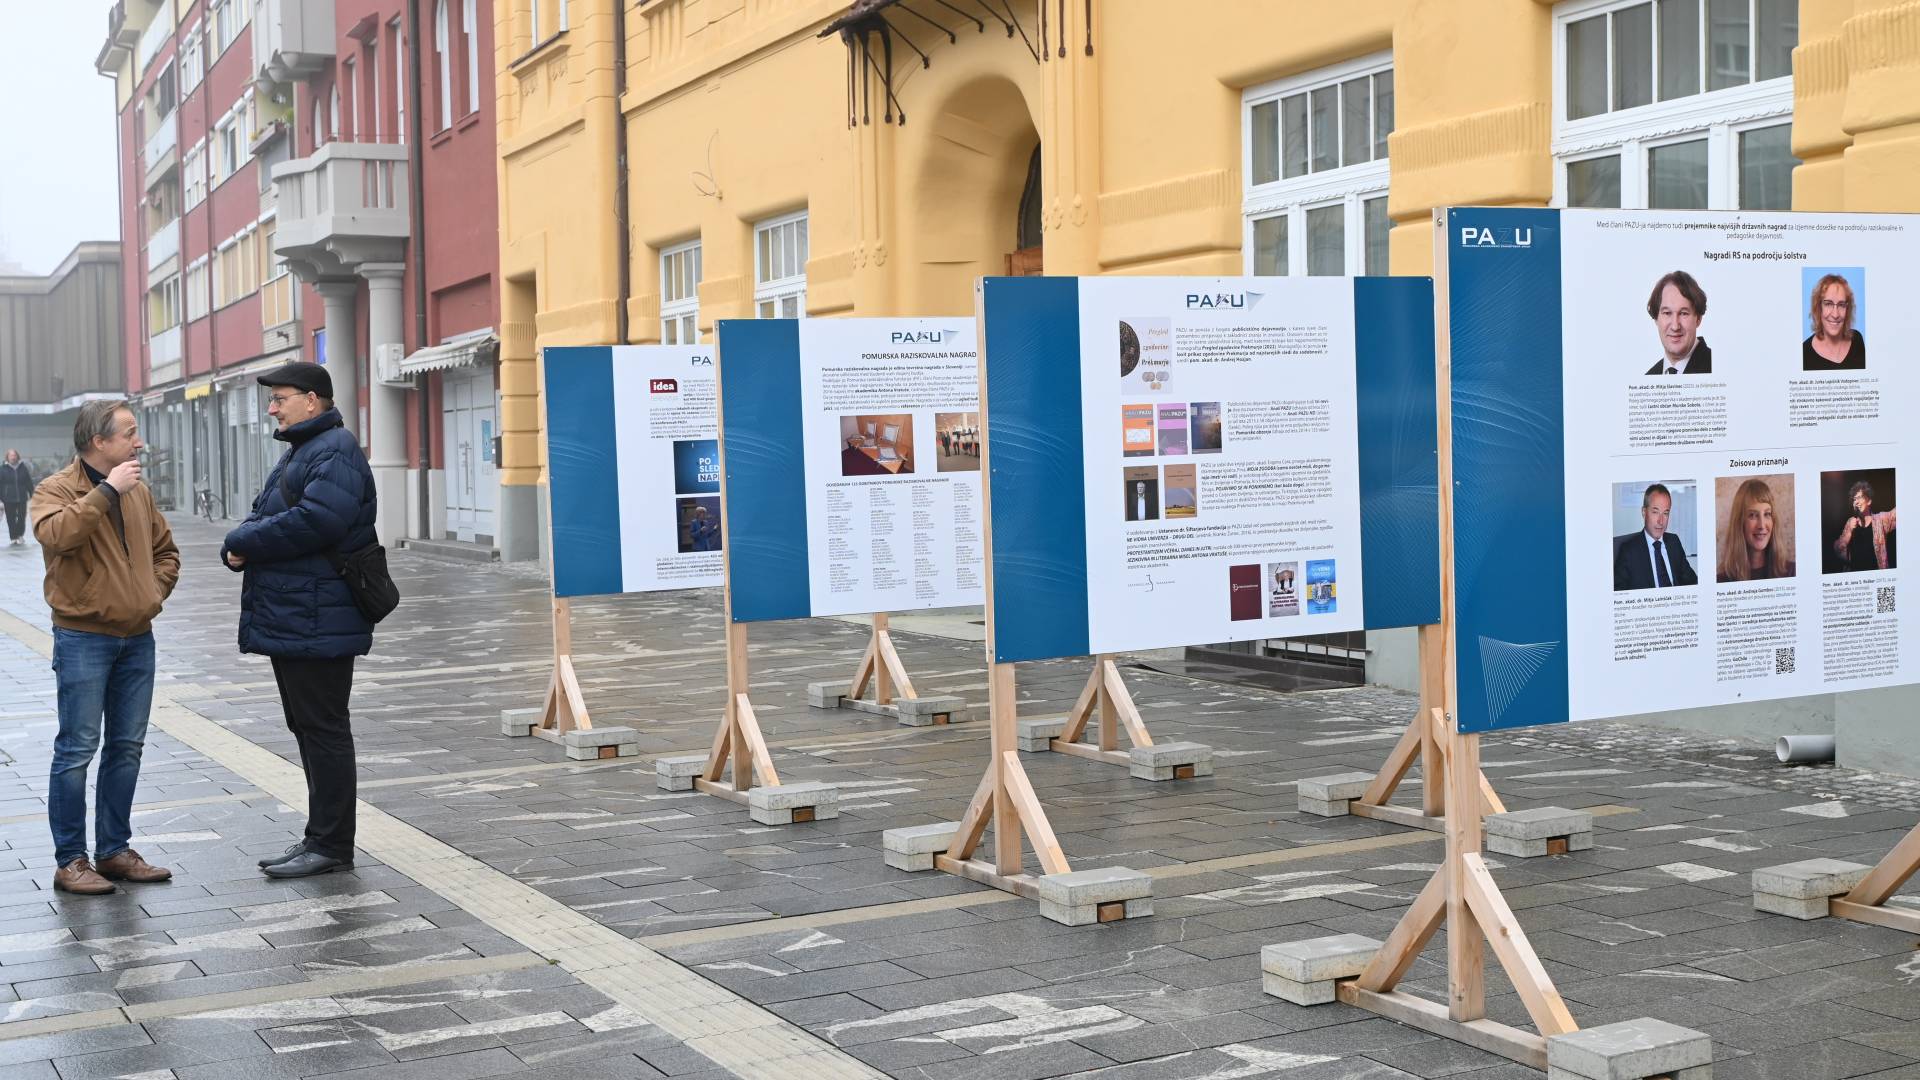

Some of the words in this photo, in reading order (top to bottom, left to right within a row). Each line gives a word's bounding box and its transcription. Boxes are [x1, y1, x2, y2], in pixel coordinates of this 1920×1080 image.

[1597, 220, 1609, 228] Med
[1647, 220, 1672, 230] najdemo
[1684, 221, 1716, 231] prejemnike
[1741, 222, 1766, 230] državnih
[1767, 222, 1787, 232] nagrad
[1704, 251, 1731, 261] Nagradi
[1732, 251, 1741, 260] RS
[1752, 251, 1782, 261] področju
[1783, 251, 1807, 260] šolstva
[653, 382, 675, 391] idea
[699, 457, 711, 465] PO
[1729, 459, 1756, 468] Zoisova
[1757, 457, 1789, 468] priznanja
